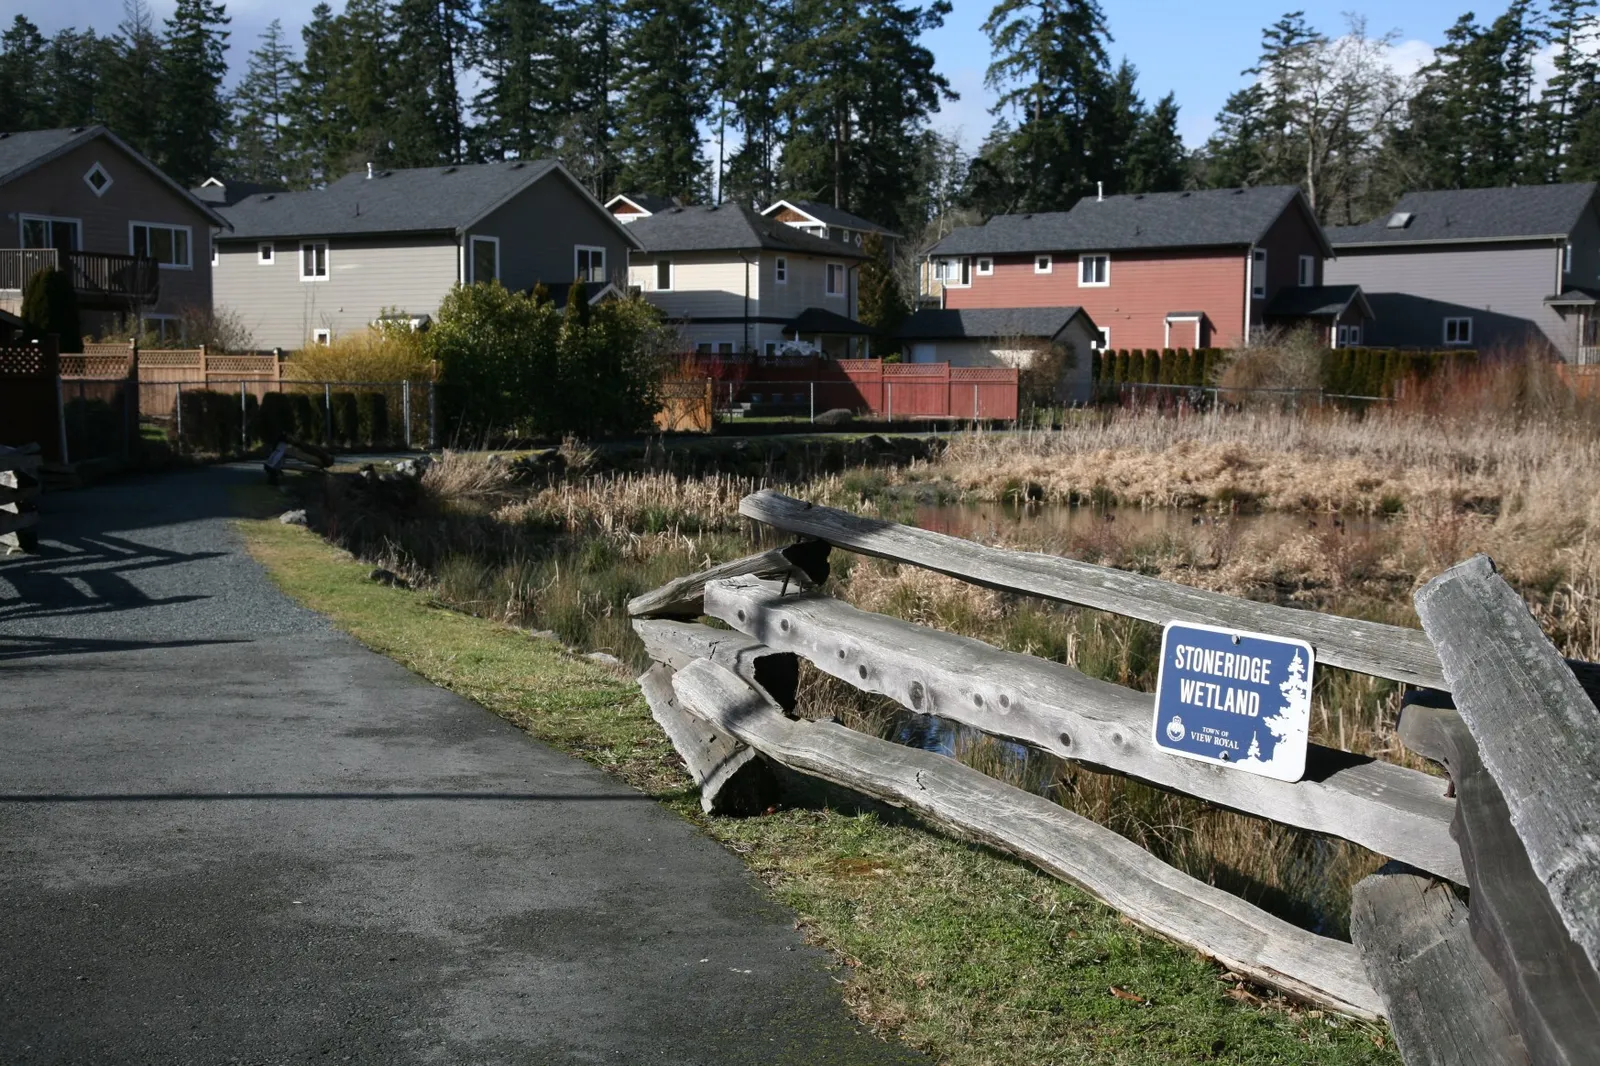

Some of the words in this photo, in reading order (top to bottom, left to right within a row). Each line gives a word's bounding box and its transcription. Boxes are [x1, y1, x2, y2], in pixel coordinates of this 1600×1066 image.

[1175, 644, 1272, 685] STONERIDGE
[1180, 678, 1260, 717] WETLAND
[1190, 731, 1212, 744] VIEW
[1214, 736, 1239, 750] ROYAL
[1202, 726, 1220, 736] TOWN
[1221, 730, 1229, 738] OF
